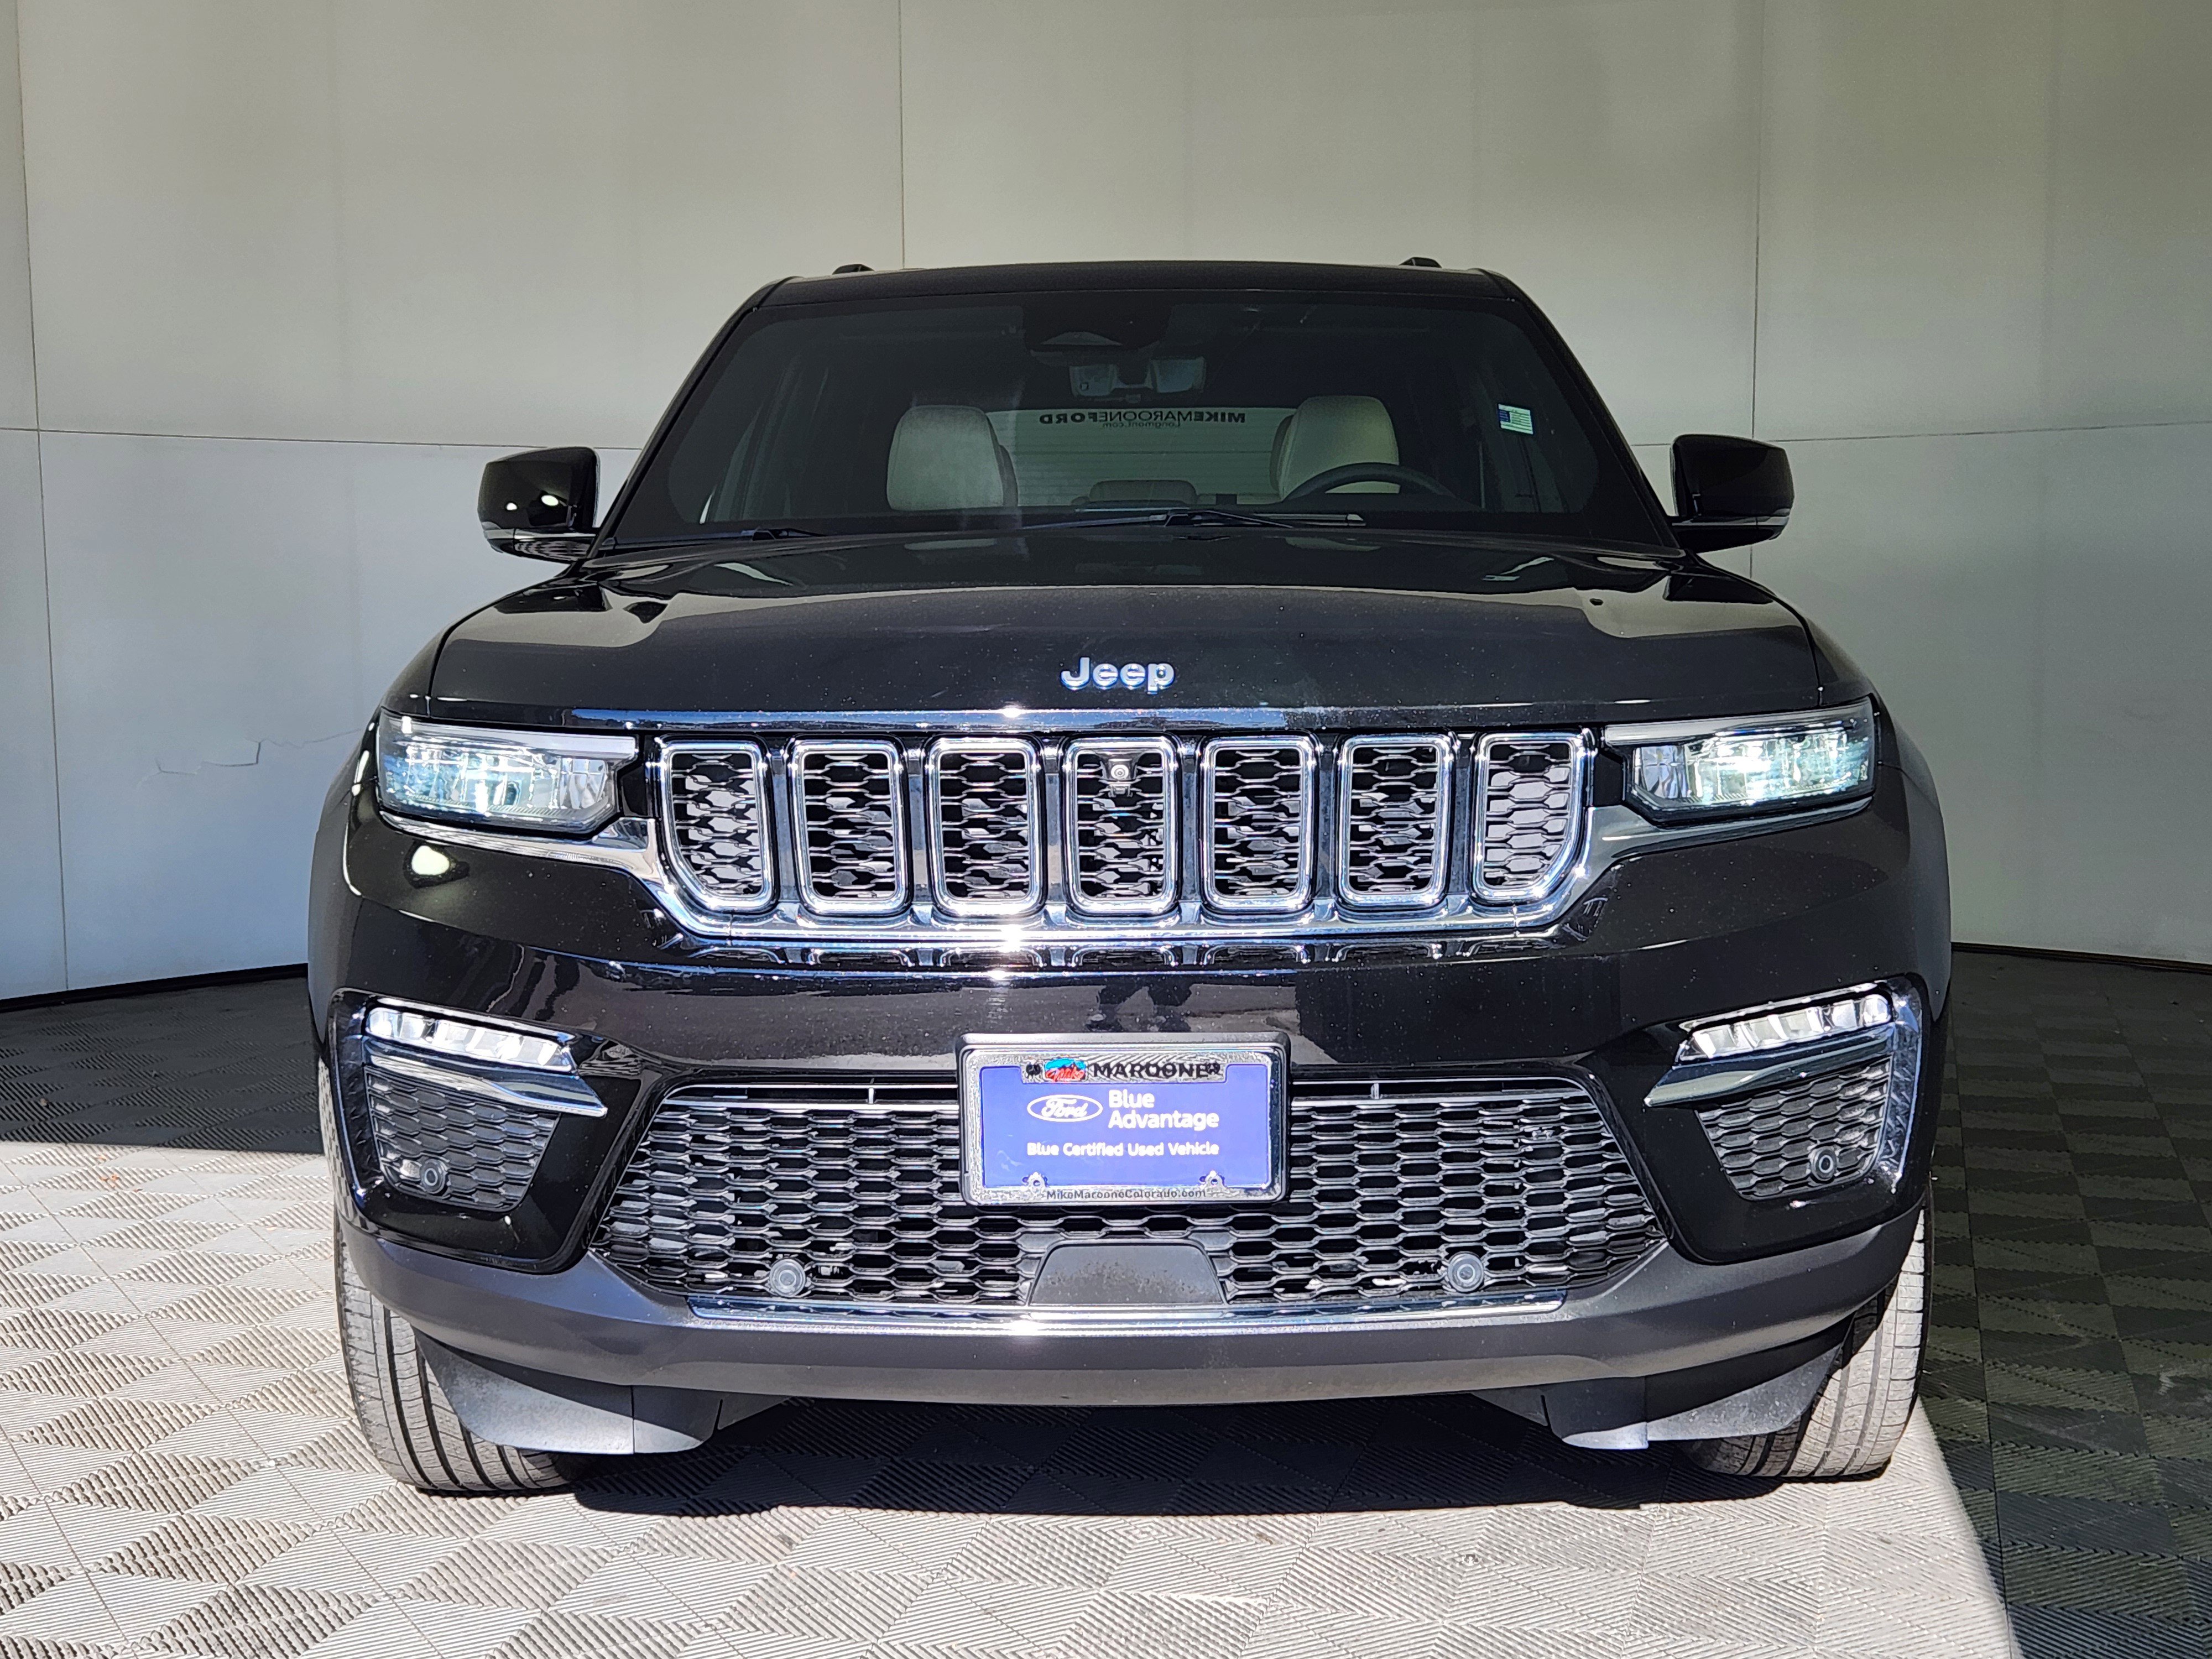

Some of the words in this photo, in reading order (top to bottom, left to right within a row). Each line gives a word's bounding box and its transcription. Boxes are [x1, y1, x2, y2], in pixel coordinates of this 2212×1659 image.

[1061, 657, 1175, 694] Jeep
[1093, 1062, 1209, 1078] MAROONE
[1041, 1098, 1088, 1118] Ford
[1108, 1089, 1155, 1109] Blue
[1108, 1109, 1220, 1131] Advantage
[1027, 1142, 1059, 1156] Blue
[1062, 1142, 1124, 1156] Certified
[1128, 1142, 1164, 1156] Used
[1167, 1141, 1220, 1155] Vehicle
